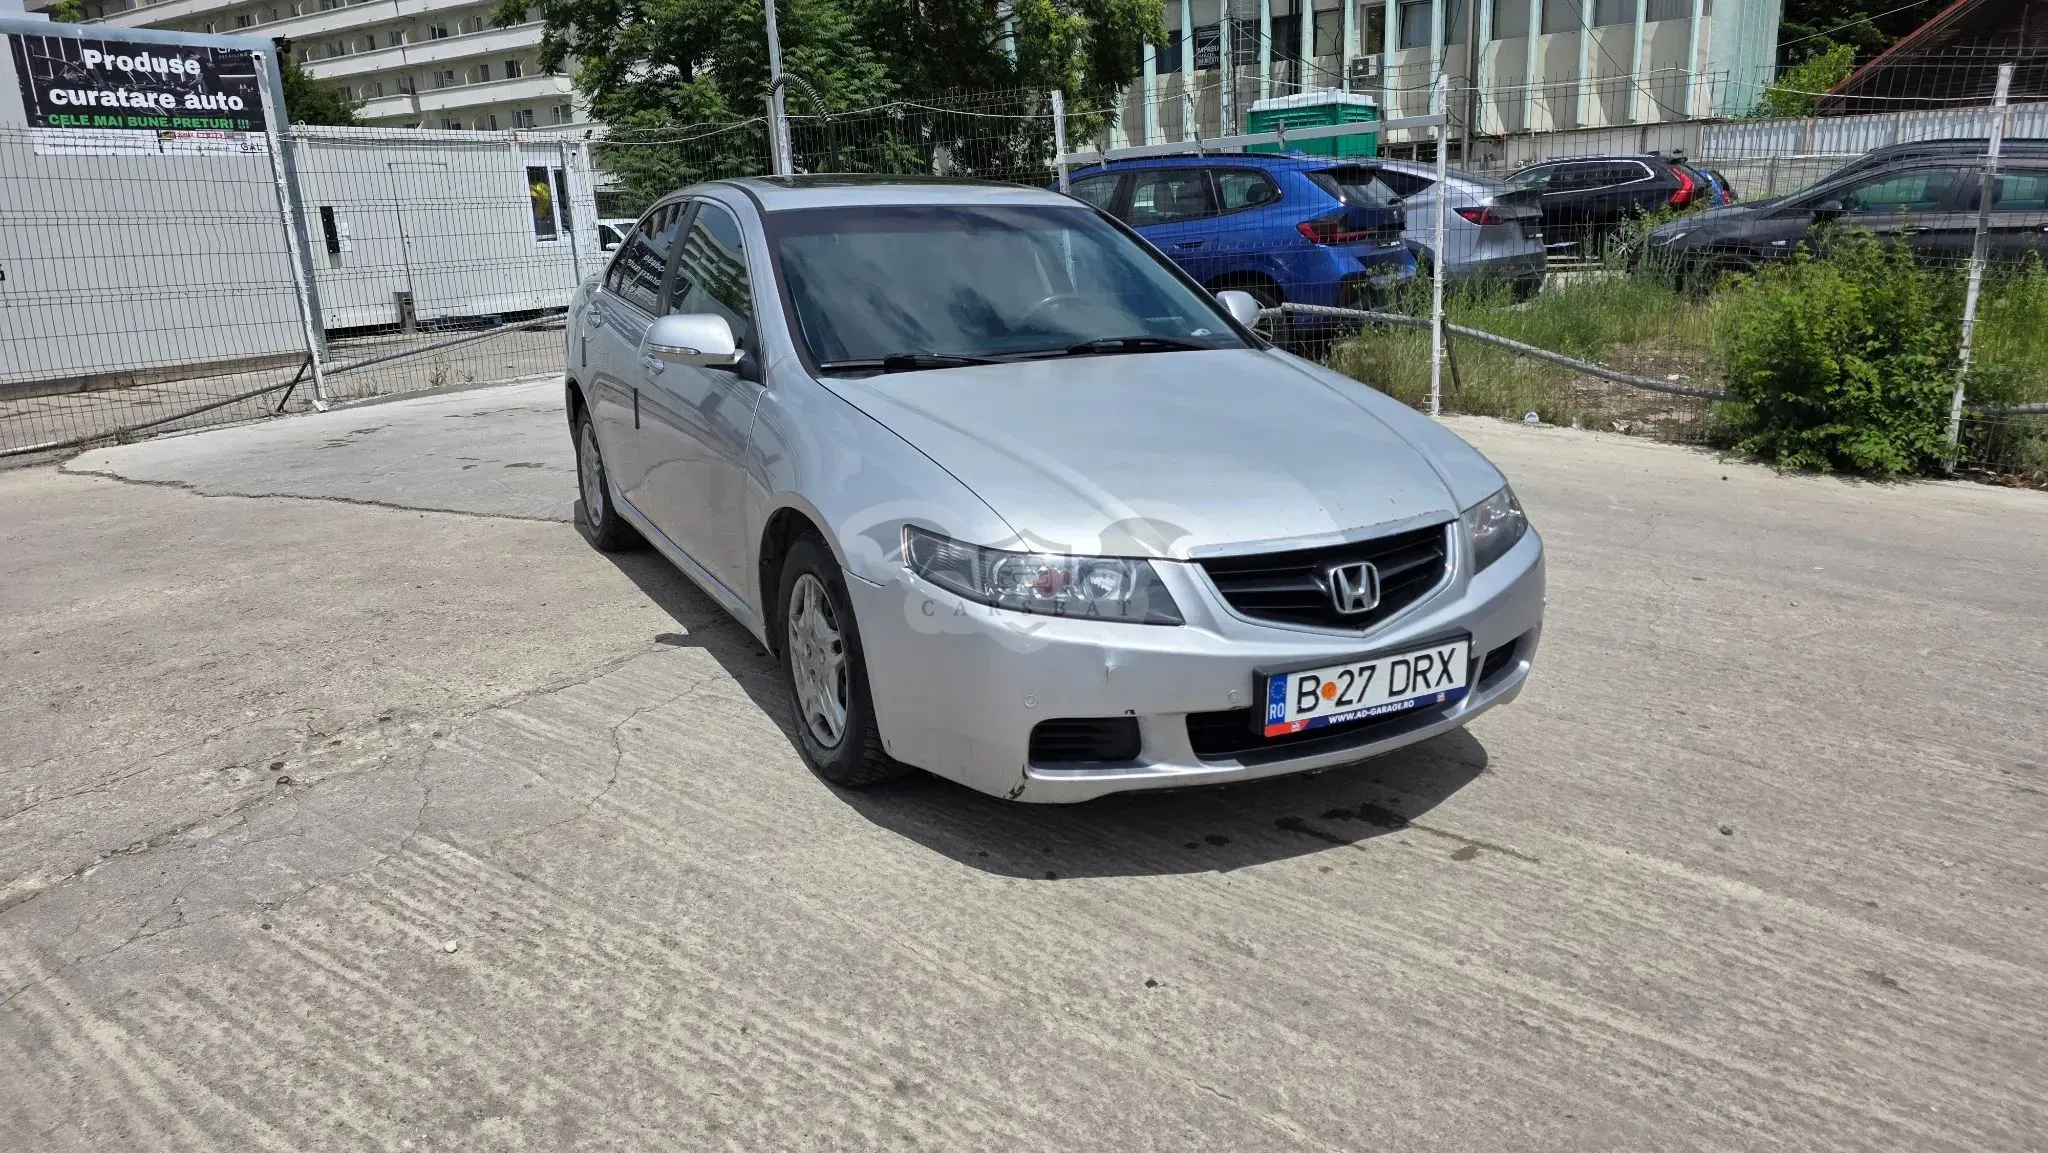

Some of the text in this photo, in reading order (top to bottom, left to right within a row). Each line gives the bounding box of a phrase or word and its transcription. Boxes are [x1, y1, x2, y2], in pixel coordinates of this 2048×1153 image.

[83, 49, 201, 75] Produse
[49, 88, 243, 111] curatare auto
[48, 114, 90, 126] CELE
[94, 115, 122, 126] MAI
[128, 116, 168, 128] BUNE
[173, 118, 234, 129] PRETURI
[1296, 647, 1457, 715] B 27 DRX
[1270, 703, 1285, 720] RO
[1328, 700, 1415, 725] WWW.AD-GARAGE.RO
